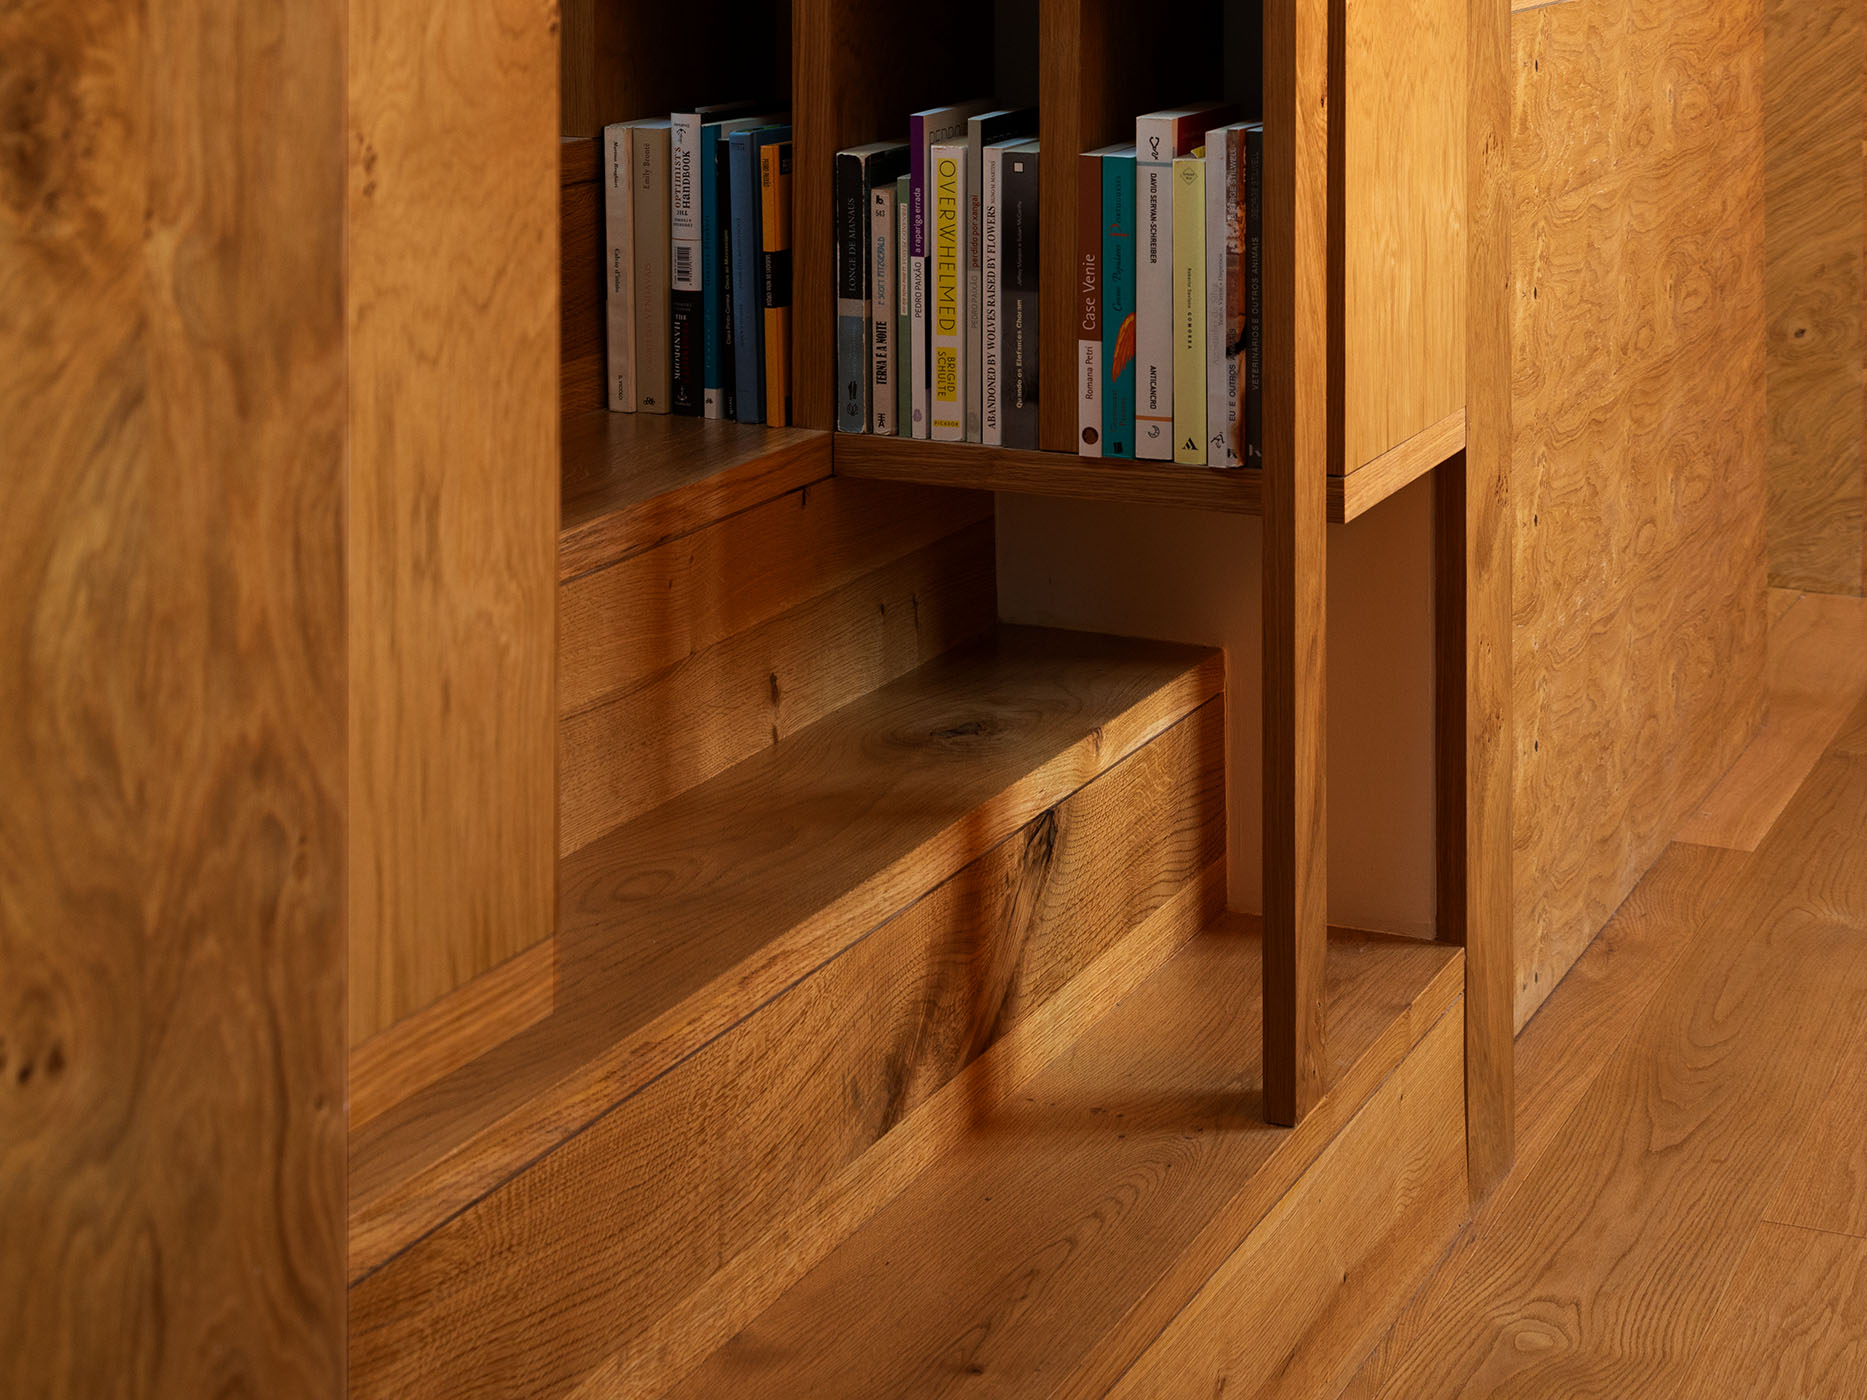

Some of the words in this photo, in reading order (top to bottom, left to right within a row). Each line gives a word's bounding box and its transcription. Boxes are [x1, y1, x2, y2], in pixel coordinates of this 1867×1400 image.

[848, 198, 856, 240] MANAUS
[972, 195, 980, 222] xangai
[914, 215, 922, 247] rapariga
[940, 160, 956, 331] OVERWHELMED
[987, 206, 996, 254] FLOWERS
[848, 242, 856, 256] DE
[972, 238, 980, 268] perdido
[987, 256, 996, 270] BY
[912, 262, 922, 290] PAIXÃO
[1082, 254, 1096, 293] Venie
[987, 272, 996, 308] RAISED
[987, 308, 996, 350] WOLVES
[1082, 298, 1096, 330] Case
[876, 321, 887, 344] NOITE
[876, 360, 887, 384] TERNA
[938, 352, 946, 397] SCHULTE
[947, 356, 956, 392] BRIGID
[987, 351, 996, 366] BY
[1018, 368, 1022, 378] os
[987, 369, 996, 430] ABANDONED
[1085, 367, 1093, 400] Romana
